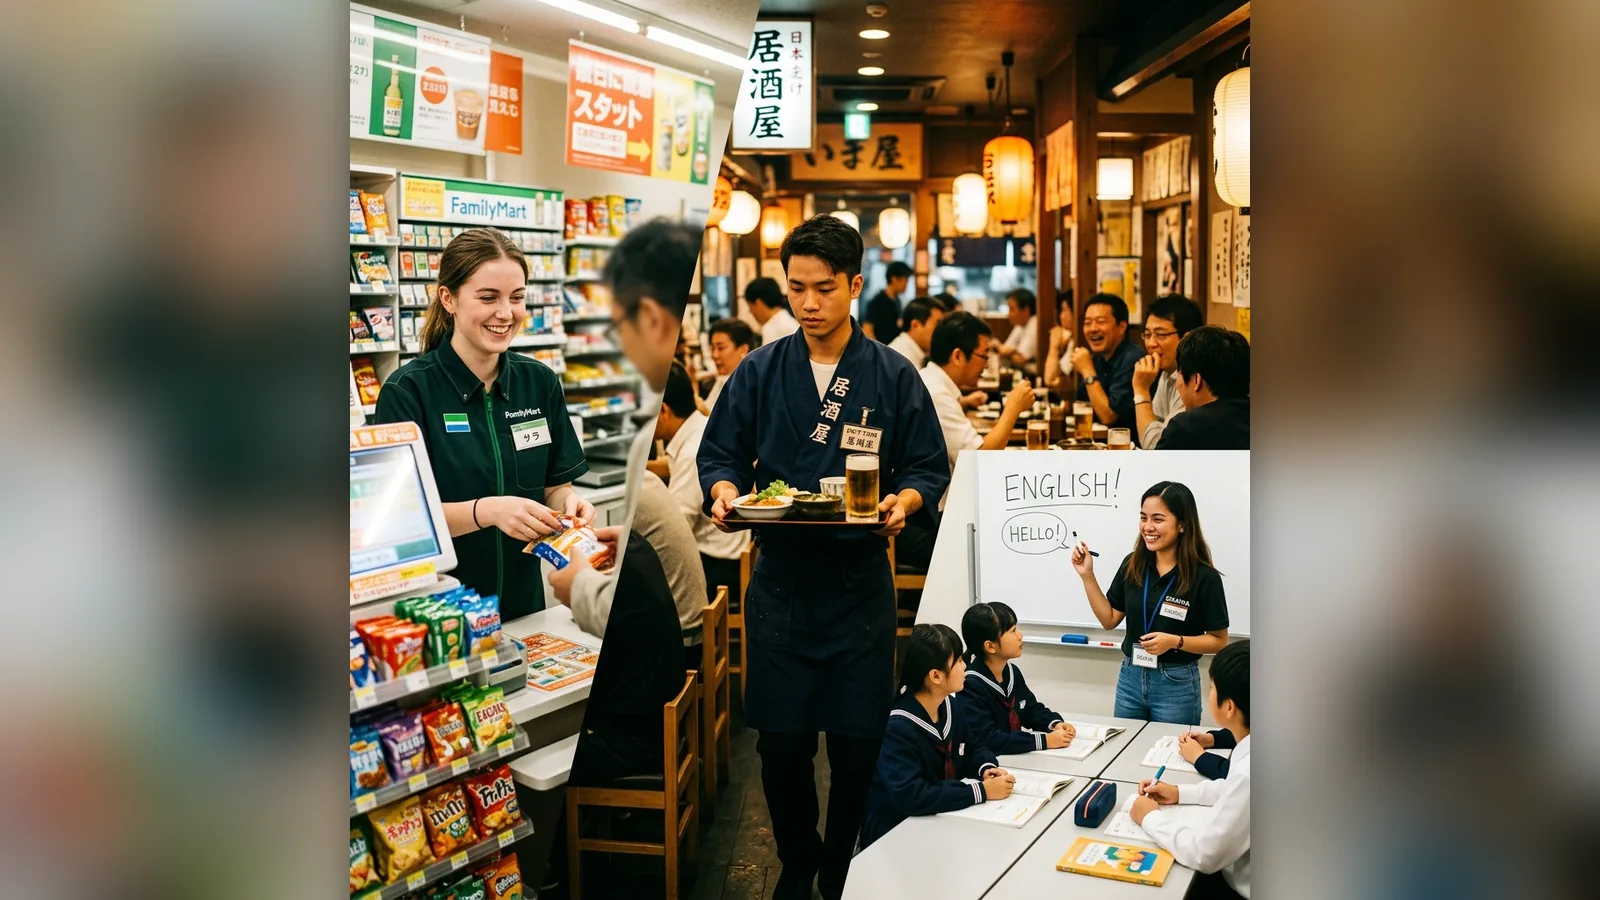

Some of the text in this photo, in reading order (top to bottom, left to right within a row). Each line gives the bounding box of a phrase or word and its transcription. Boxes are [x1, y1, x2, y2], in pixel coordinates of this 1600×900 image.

[748, 29, 784, 139] 居酒屋
[574, 88, 643, 130] スタット
[450, 196, 527, 221] FamilyMart
[809, 376, 850, 445] 居酒屋
[1005, 467, 1121, 502] ENGLISH!
[1009, 523, 1060, 543] HELLO!
